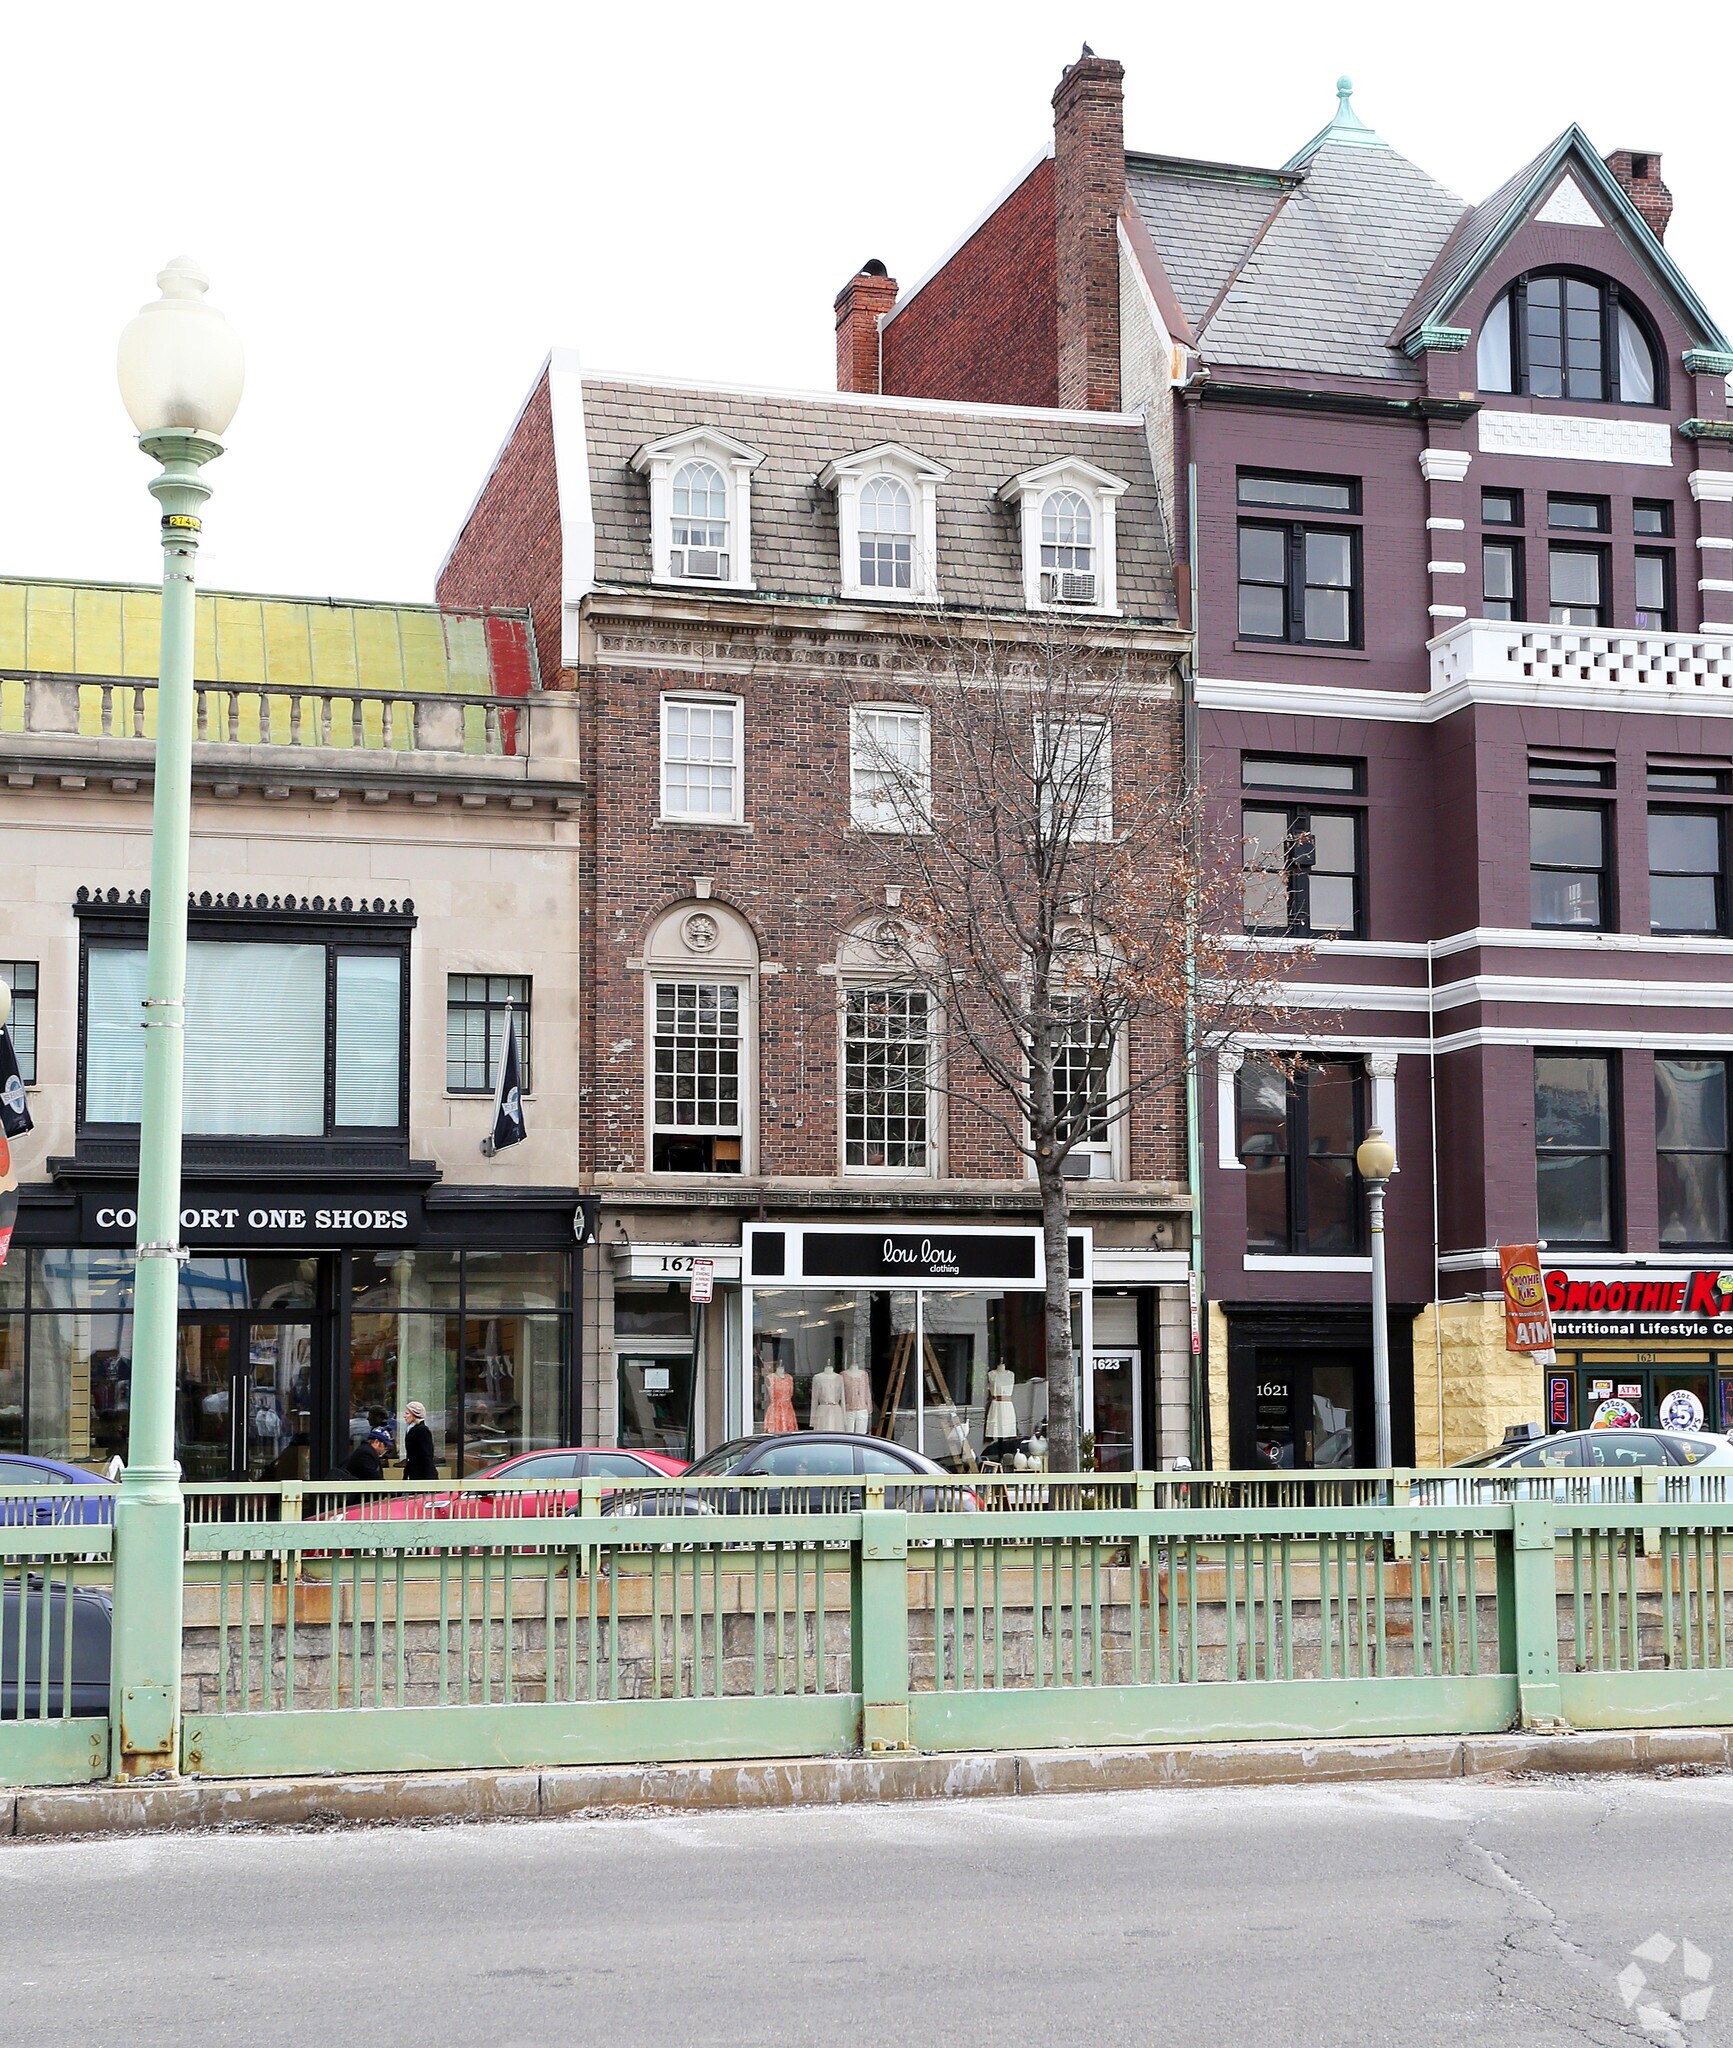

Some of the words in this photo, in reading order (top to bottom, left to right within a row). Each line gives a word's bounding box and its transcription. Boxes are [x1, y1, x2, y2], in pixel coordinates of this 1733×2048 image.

[96, 1208, 239, 1228] COORT
[248, 1209, 307, 1228] ONE
[315, 1209, 408, 1229] SHOES
[882, 1238, 918, 1263] lou
[920, 1239, 957, 1263] lou
[661, 1257, 694, 1271] 162
[930, 1264, 960, 1275] clothing
[1510, 1273, 1540, 1286] SMOOTHIE
[1544, 1270, 1687, 1312] SMOOTHIE
[1515, 1321, 1551, 1344] ATM
[1640, 1322, 1708, 1337] Lifestyle
[1093, 1358, 1120, 1370] 1623
[1636, 1353, 1656, 1363] 1621
[1256, 1382, 1289, 1396] 1621
[1553, 1381, 1566, 1421] OPEN
[1662, 1417, 1701, 1431] MOAYS
